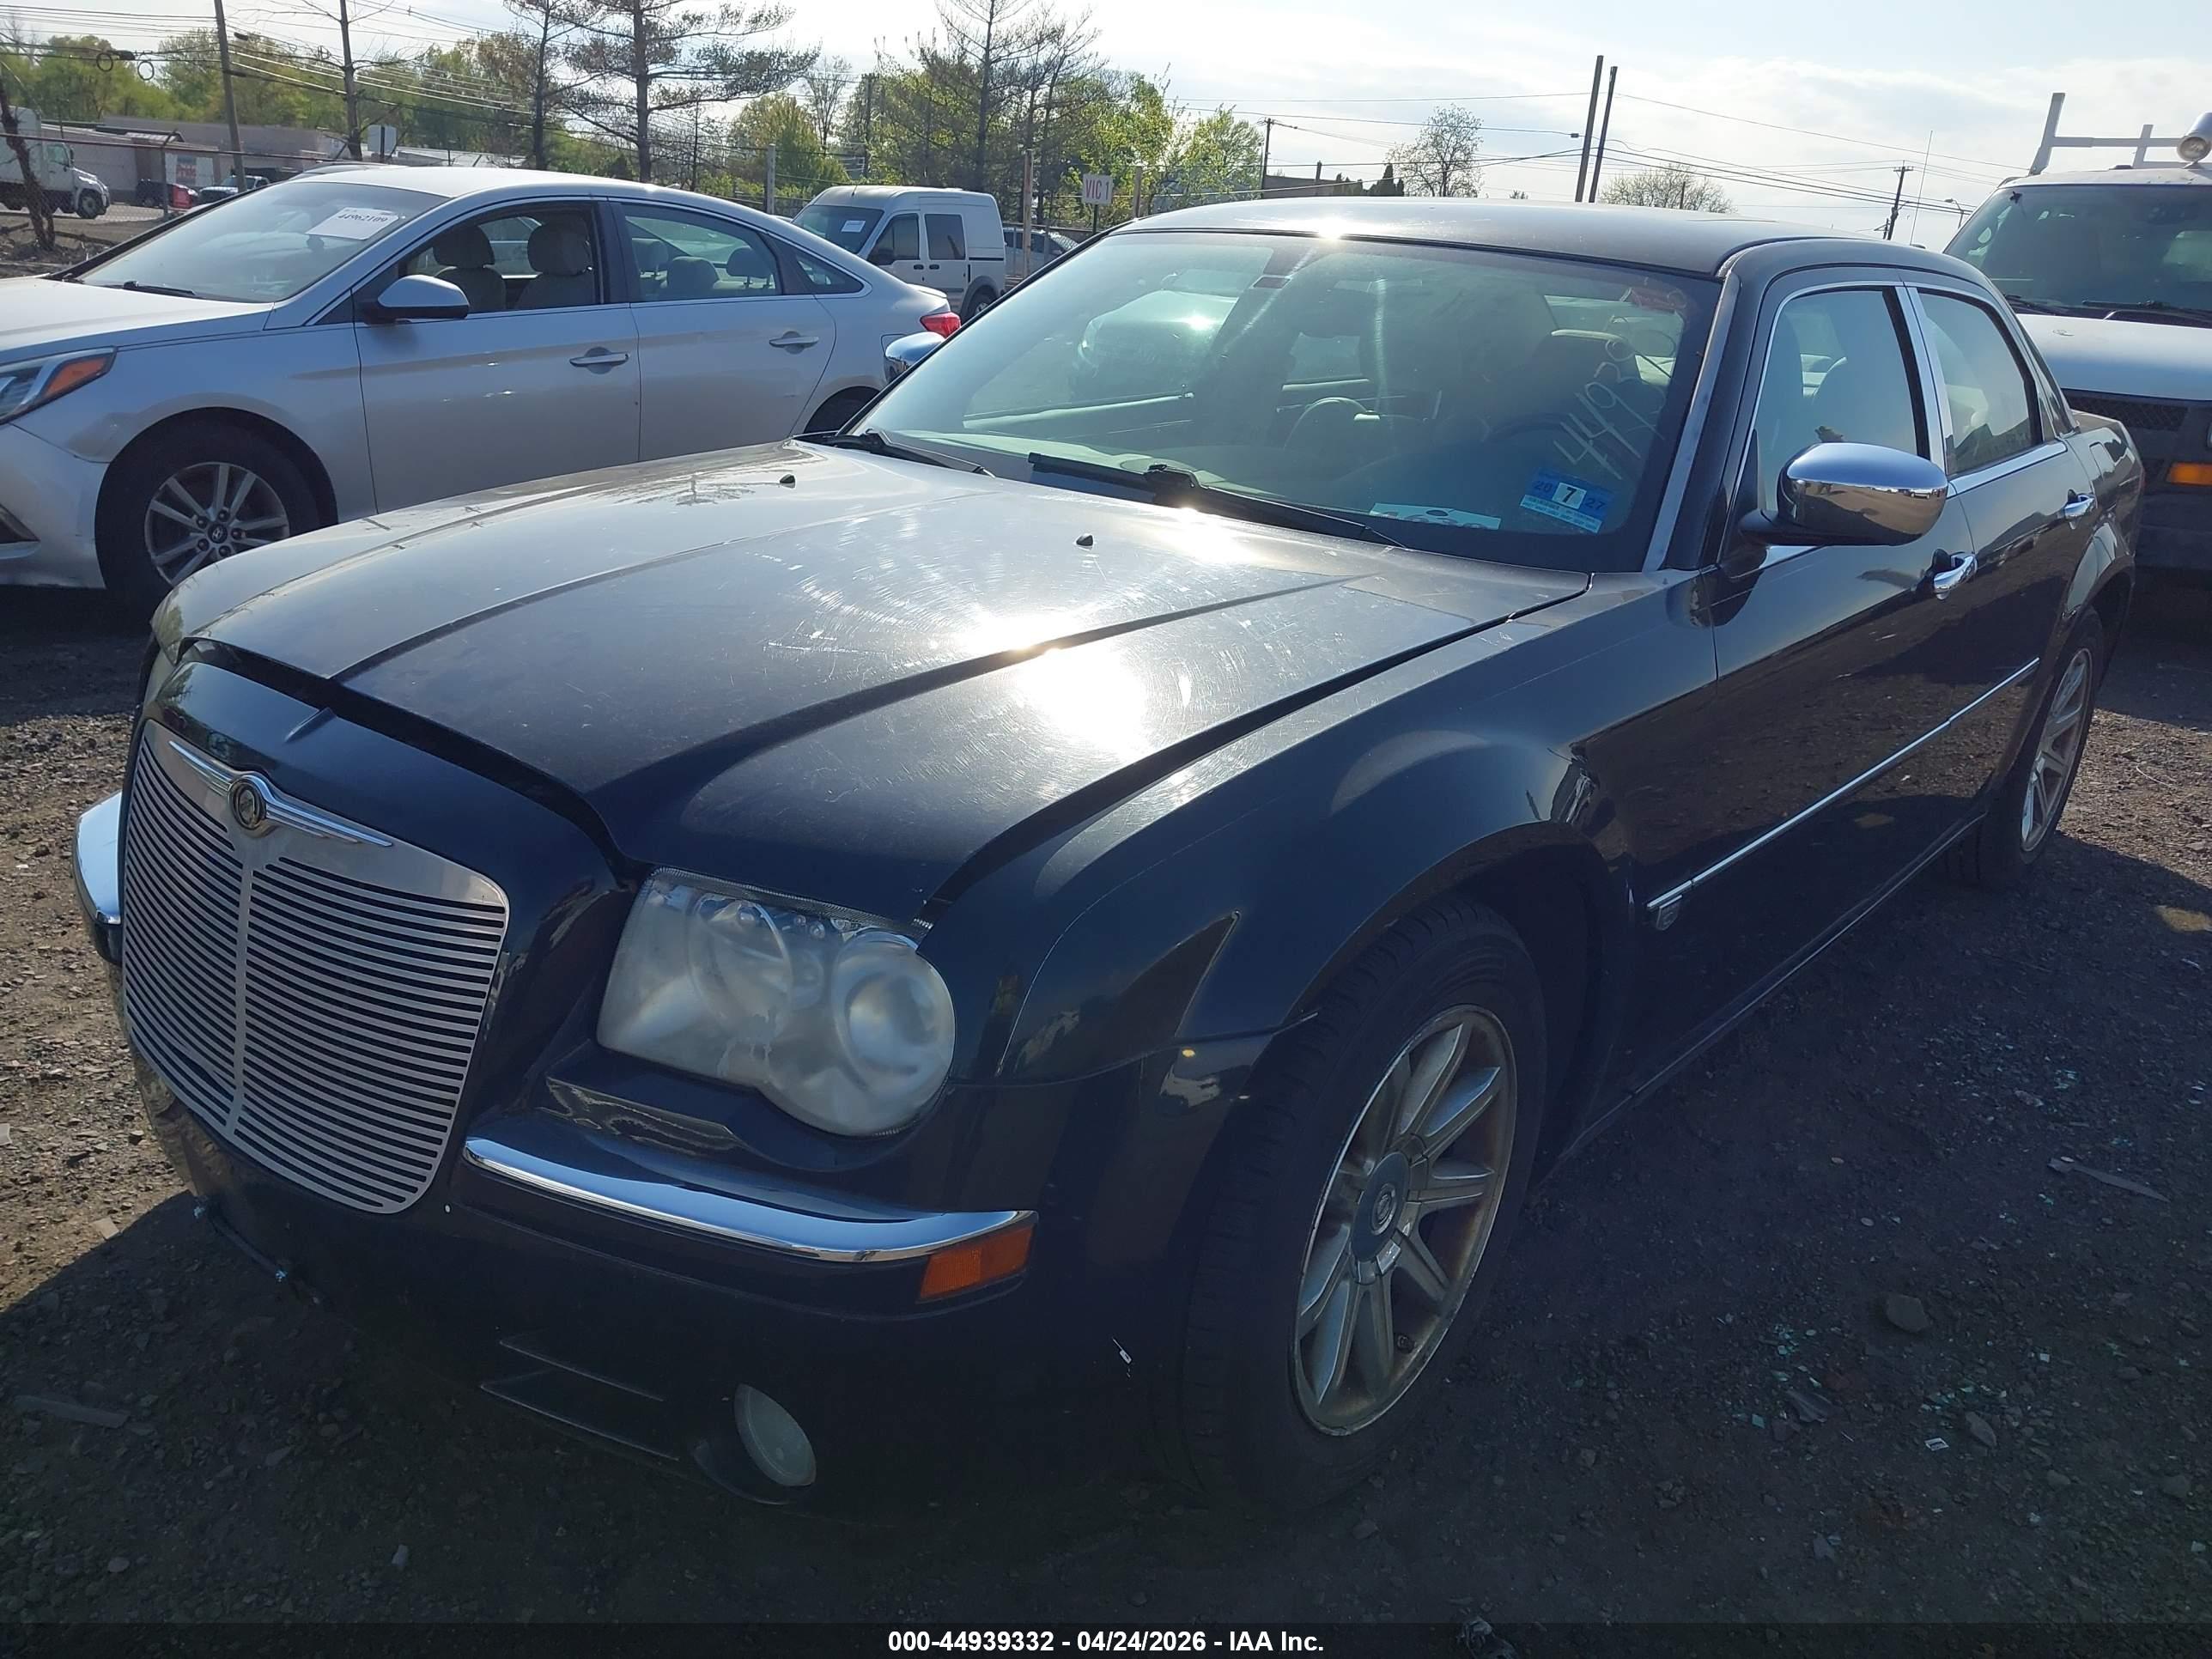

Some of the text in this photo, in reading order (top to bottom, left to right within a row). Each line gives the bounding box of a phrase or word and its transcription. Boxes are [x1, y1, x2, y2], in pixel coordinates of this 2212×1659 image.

[1086, 179, 1103, 199] VIC
[1562, 487, 1577, 503] 7
[1583, 497, 1607, 511] 27
